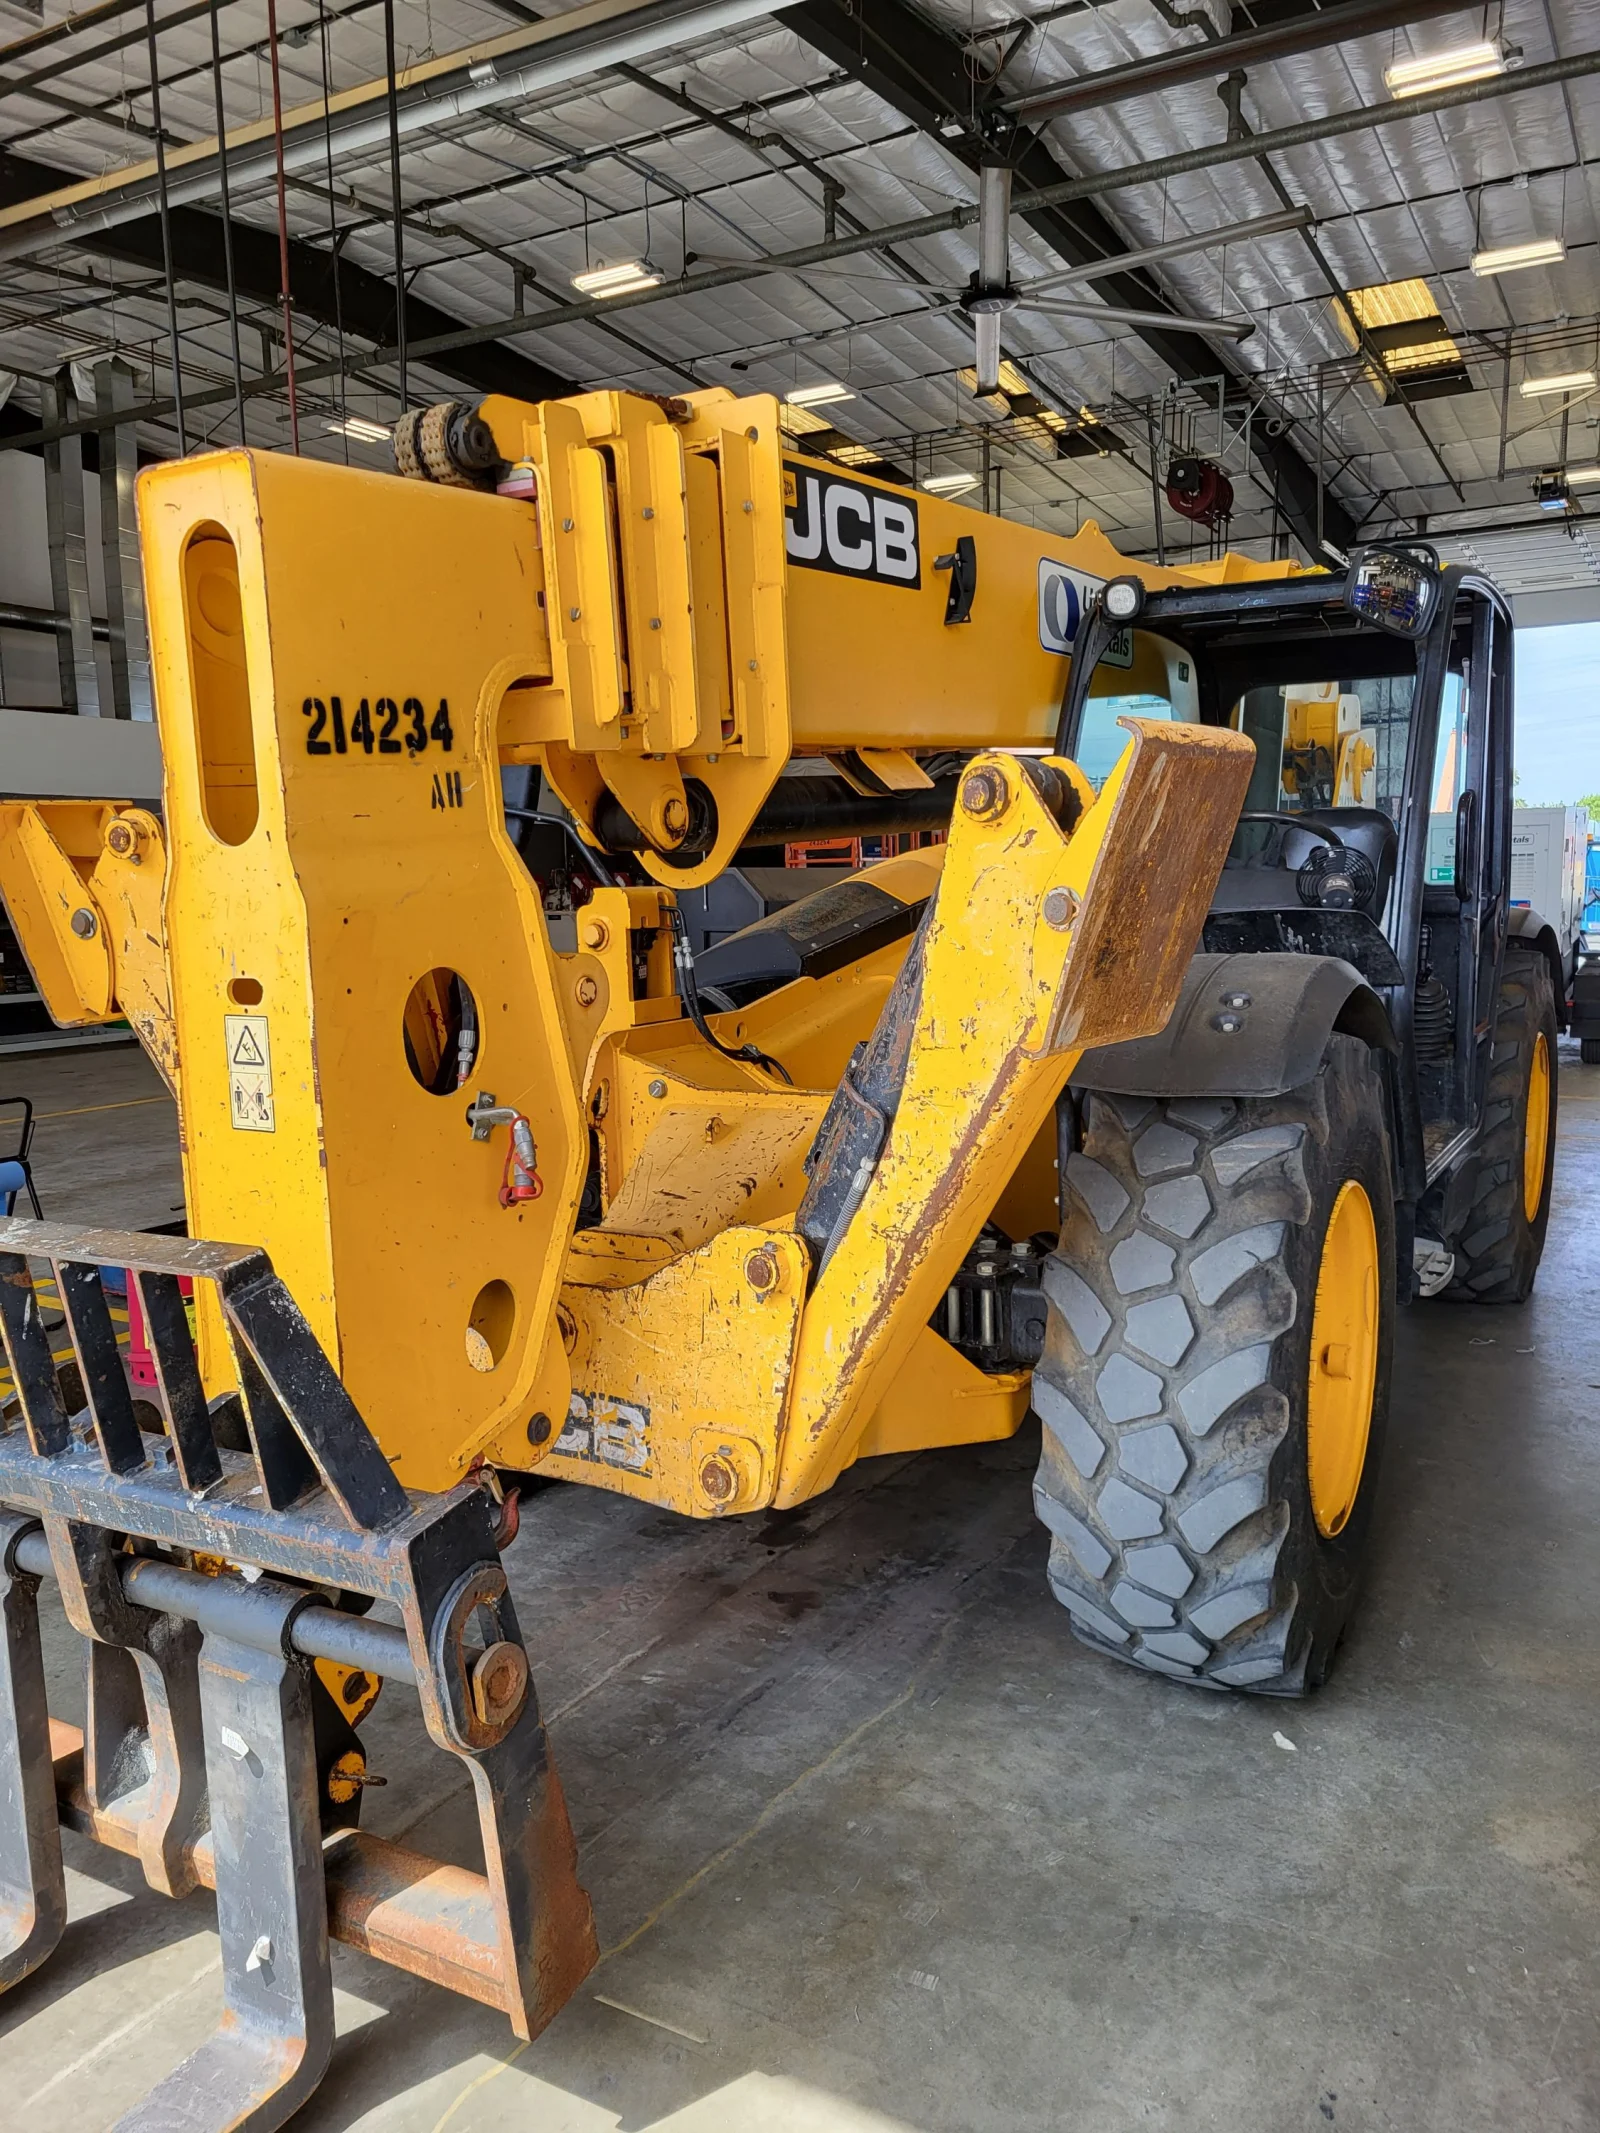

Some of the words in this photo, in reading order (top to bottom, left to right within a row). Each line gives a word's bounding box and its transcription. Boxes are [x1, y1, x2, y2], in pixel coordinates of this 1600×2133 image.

[784, 476, 918, 580] JCB
[302, 696, 454, 756] 214234
[1513, 835, 1530, 844] tals
[554, 1393, 649, 1468] CB
